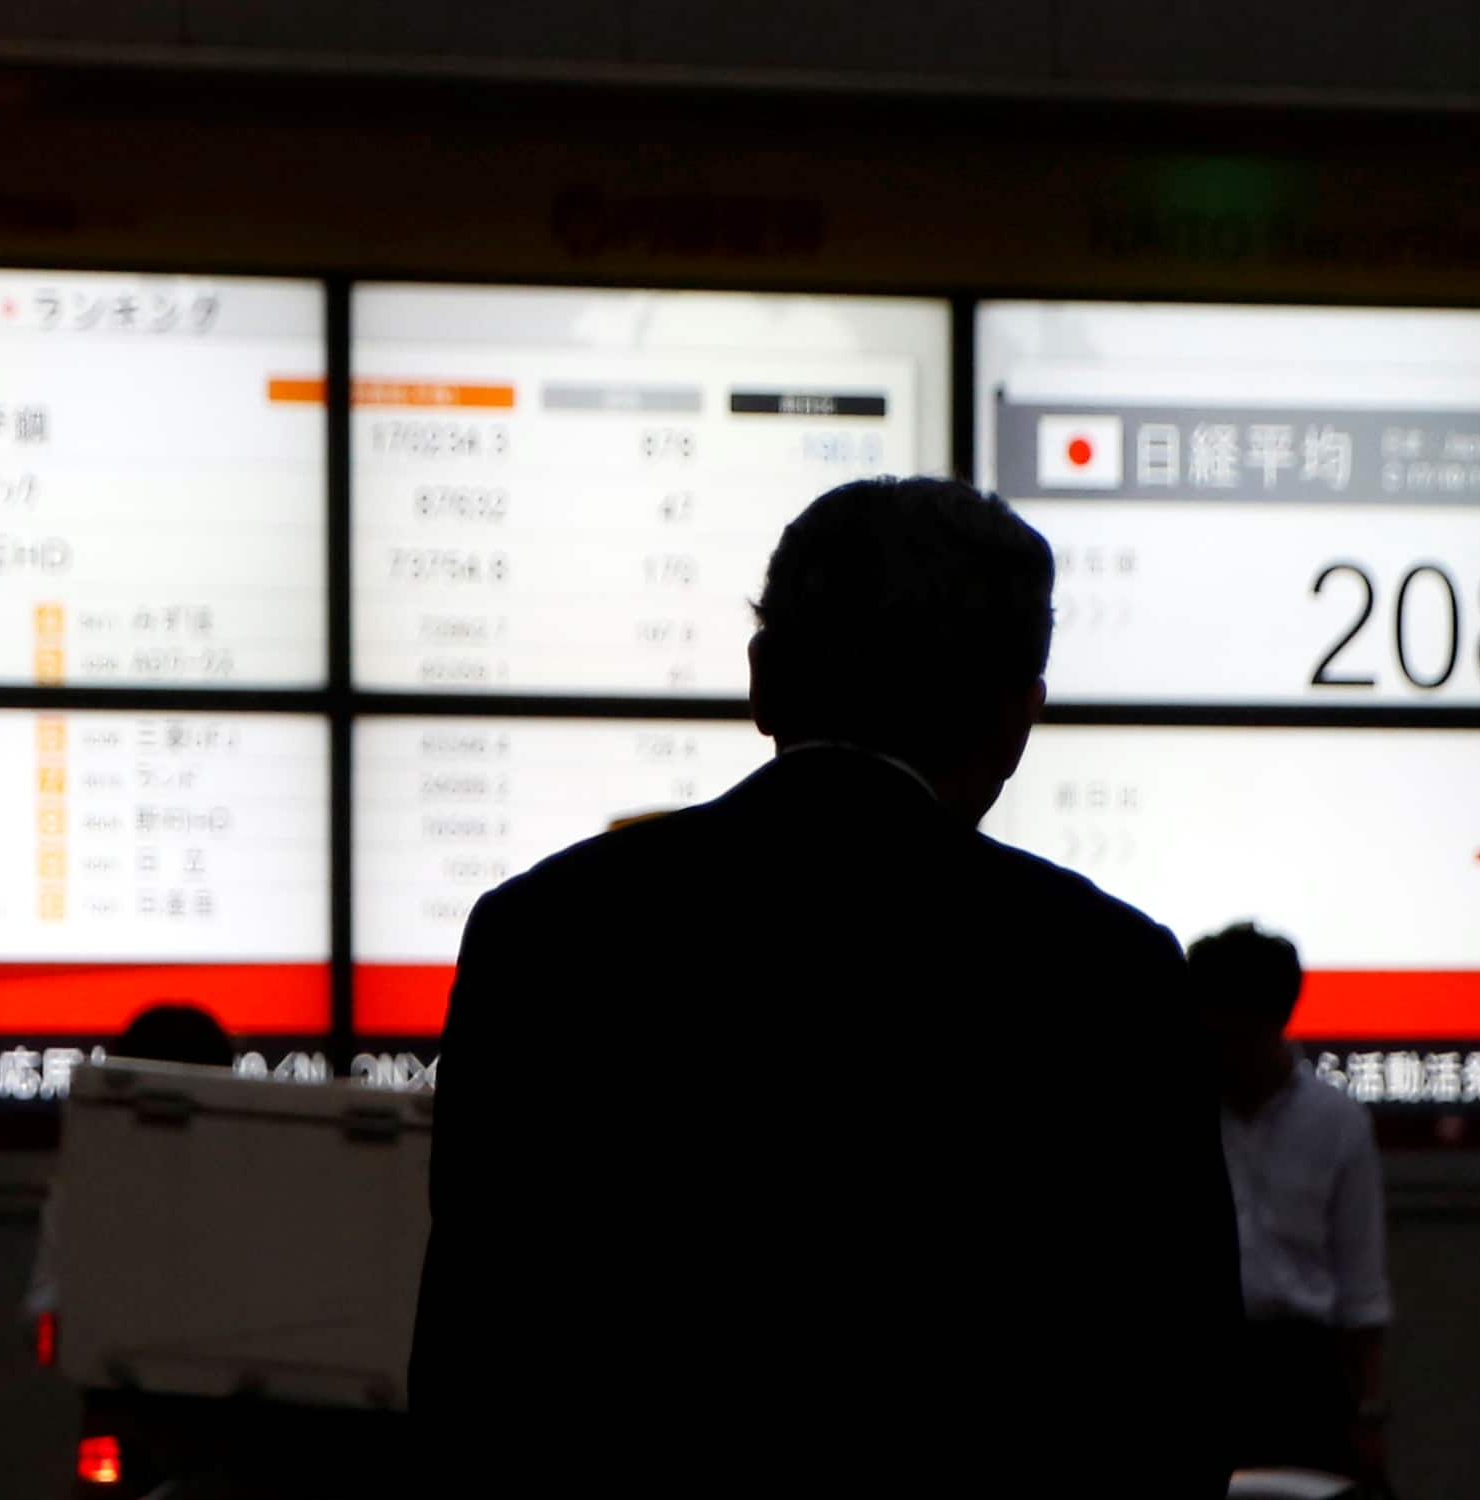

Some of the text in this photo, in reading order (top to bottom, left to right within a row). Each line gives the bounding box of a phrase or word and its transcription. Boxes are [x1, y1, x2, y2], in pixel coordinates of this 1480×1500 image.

[34, 288, 222, 330] ランキング
[1135, 421, 1353, 490] 日経平均
